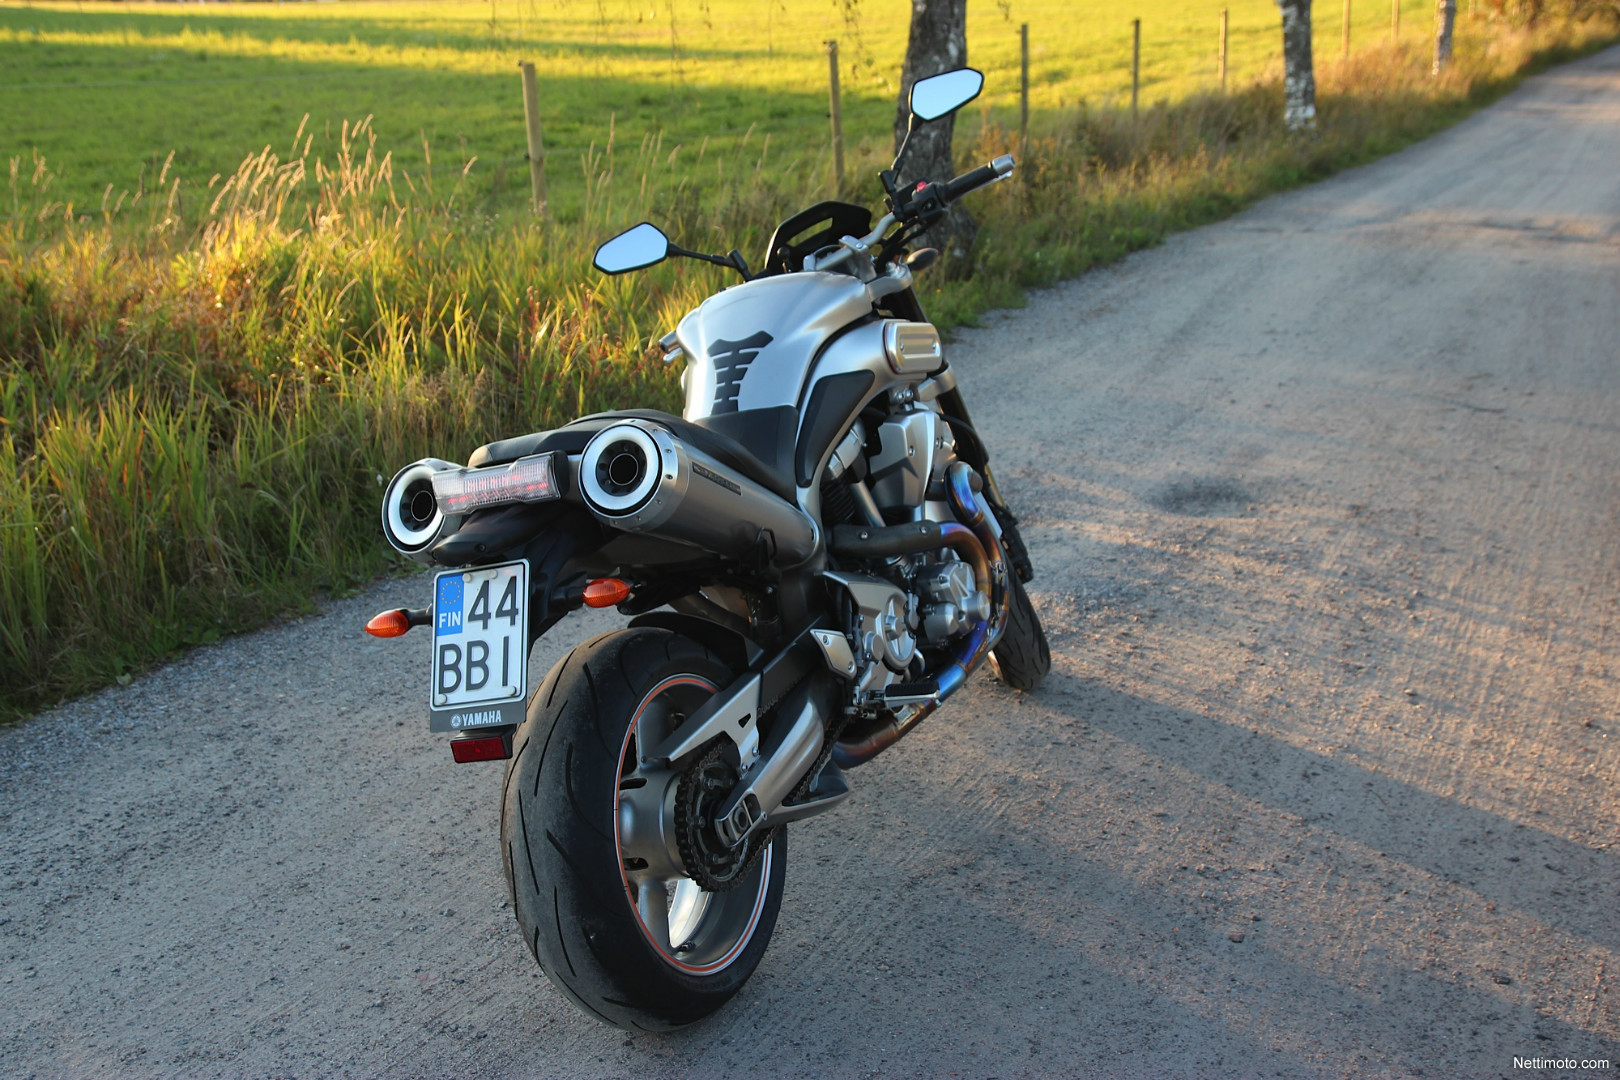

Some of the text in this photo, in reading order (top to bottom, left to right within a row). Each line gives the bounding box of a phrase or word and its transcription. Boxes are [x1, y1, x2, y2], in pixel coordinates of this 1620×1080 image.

[438, 610, 461, 629] FIN
[468, 575, 519, 630] 44
[438, 636, 510, 695] BBI
[462, 710, 502, 726] YAMAHA
